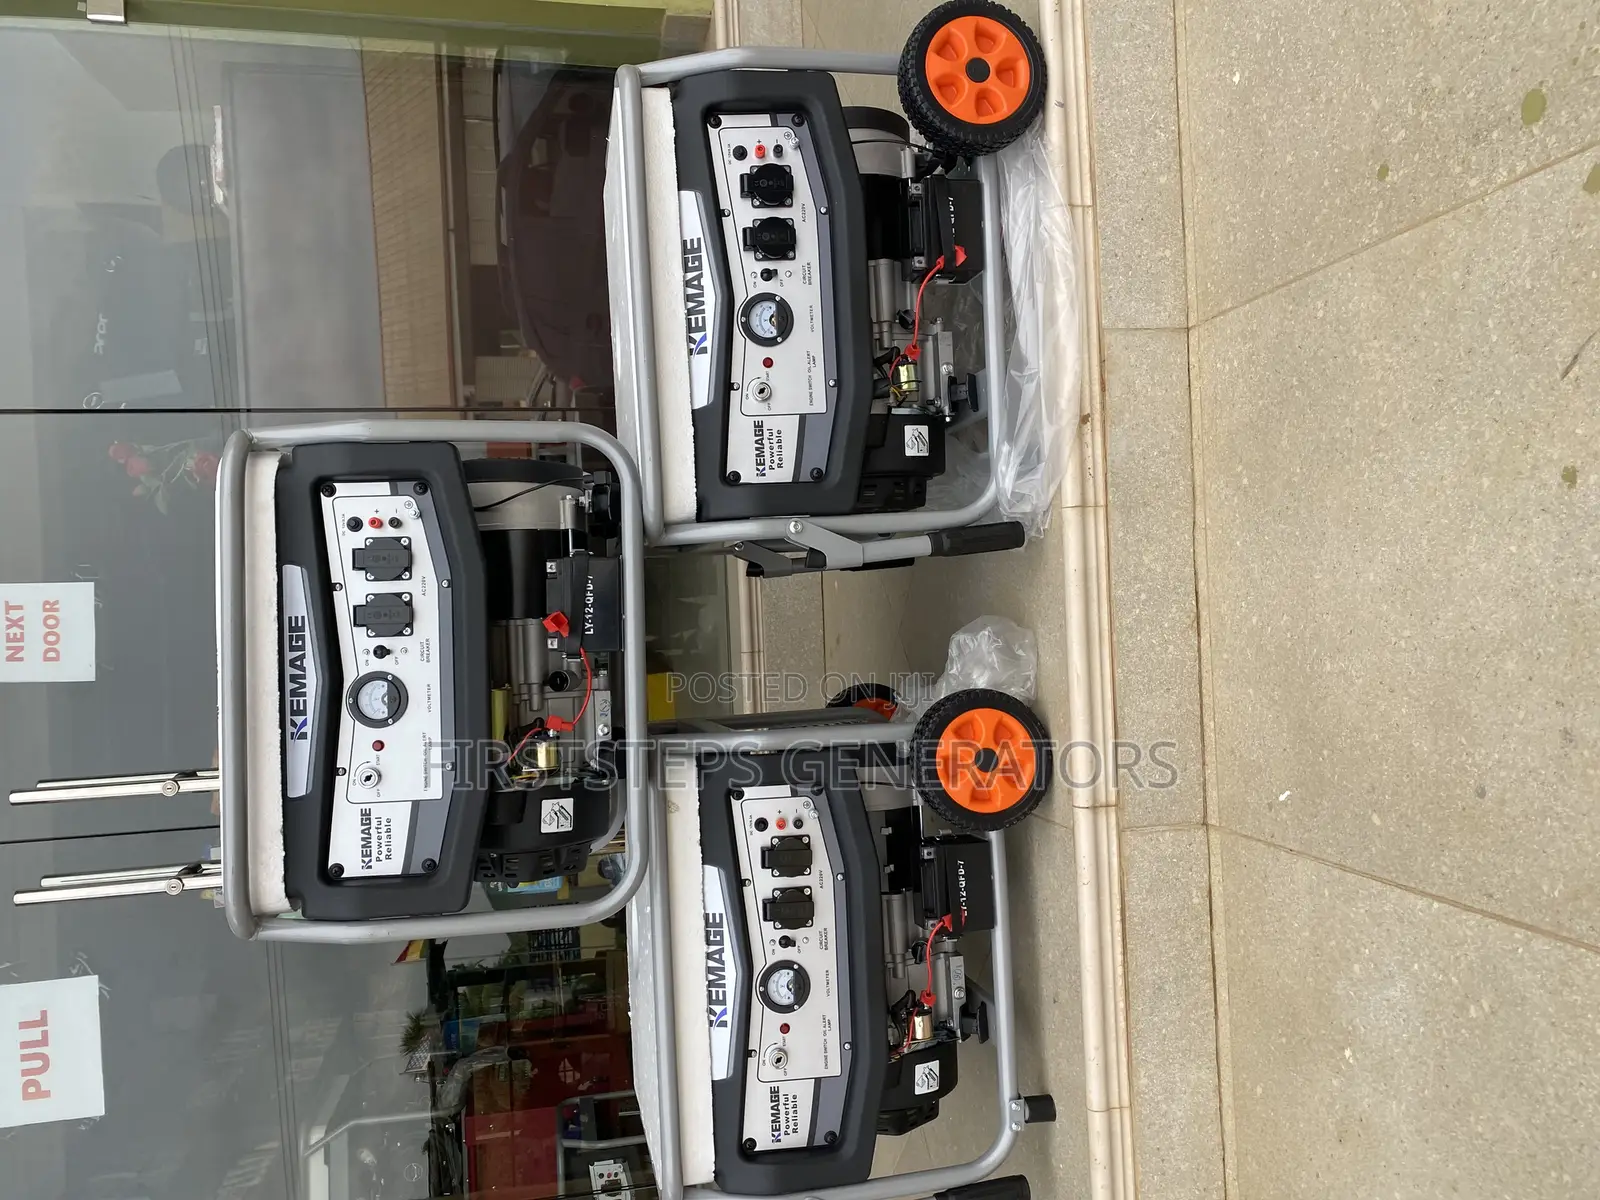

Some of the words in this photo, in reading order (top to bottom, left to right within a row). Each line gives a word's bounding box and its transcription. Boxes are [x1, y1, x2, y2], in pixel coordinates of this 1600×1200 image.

[683, 237, 707, 357] KEMAGE
[753, 420, 766, 477] KEMAGE
[767, 428, 776, 470] Powerful
[776, 429, 784, 468] Reliable
[4, 600, 24, 662] NEXT
[42, 600, 61, 662] DOOR
[288, 615, 308, 743] KEMAGE
[352, 778, 357, 786] ON
[360, 808, 372, 870] KEMAGE
[375, 816, 383, 862] Powerful
[384, 817, 392, 860] Reliable
[706, 913, 727, 1030] KEMAGE
[18, 1010, 51, 1101] PULL
[770, 1086, 781, 1143] KEMAGE
[782, 1094, 791, 1135] Powerful
[791, 1094, 799, 1134] Reliable
